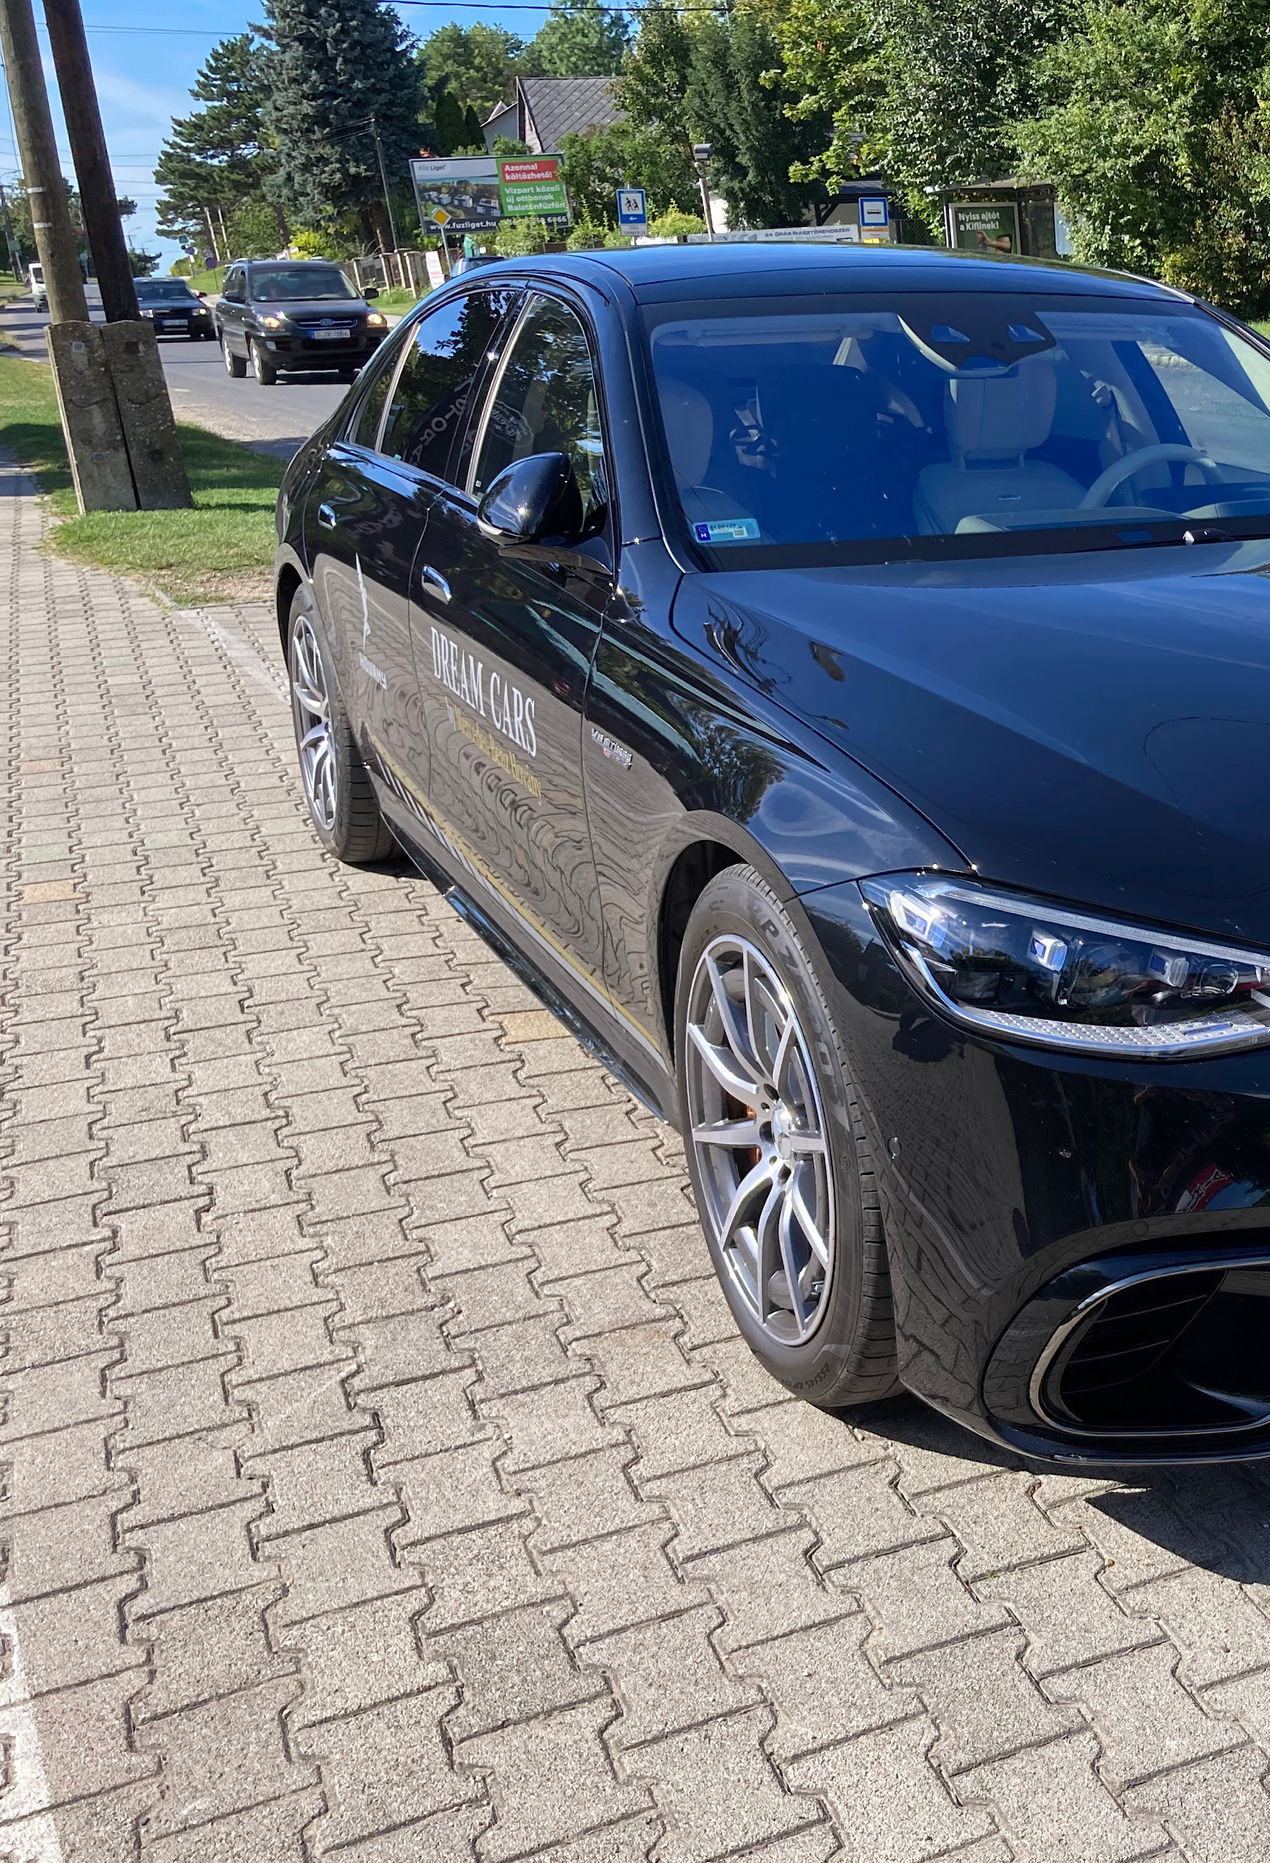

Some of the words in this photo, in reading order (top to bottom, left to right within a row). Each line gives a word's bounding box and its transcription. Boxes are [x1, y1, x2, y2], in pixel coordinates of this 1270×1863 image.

[504, 163, 538, 172] Azonnal
[505, 171, 553, 180] költözhető!
[957, 212, 980, 222] Nyiss
[980, 211, 1001, 222] ajtót
[430, 626, 487, 718] DREAM
[489, 671, 538, 758] CARS
